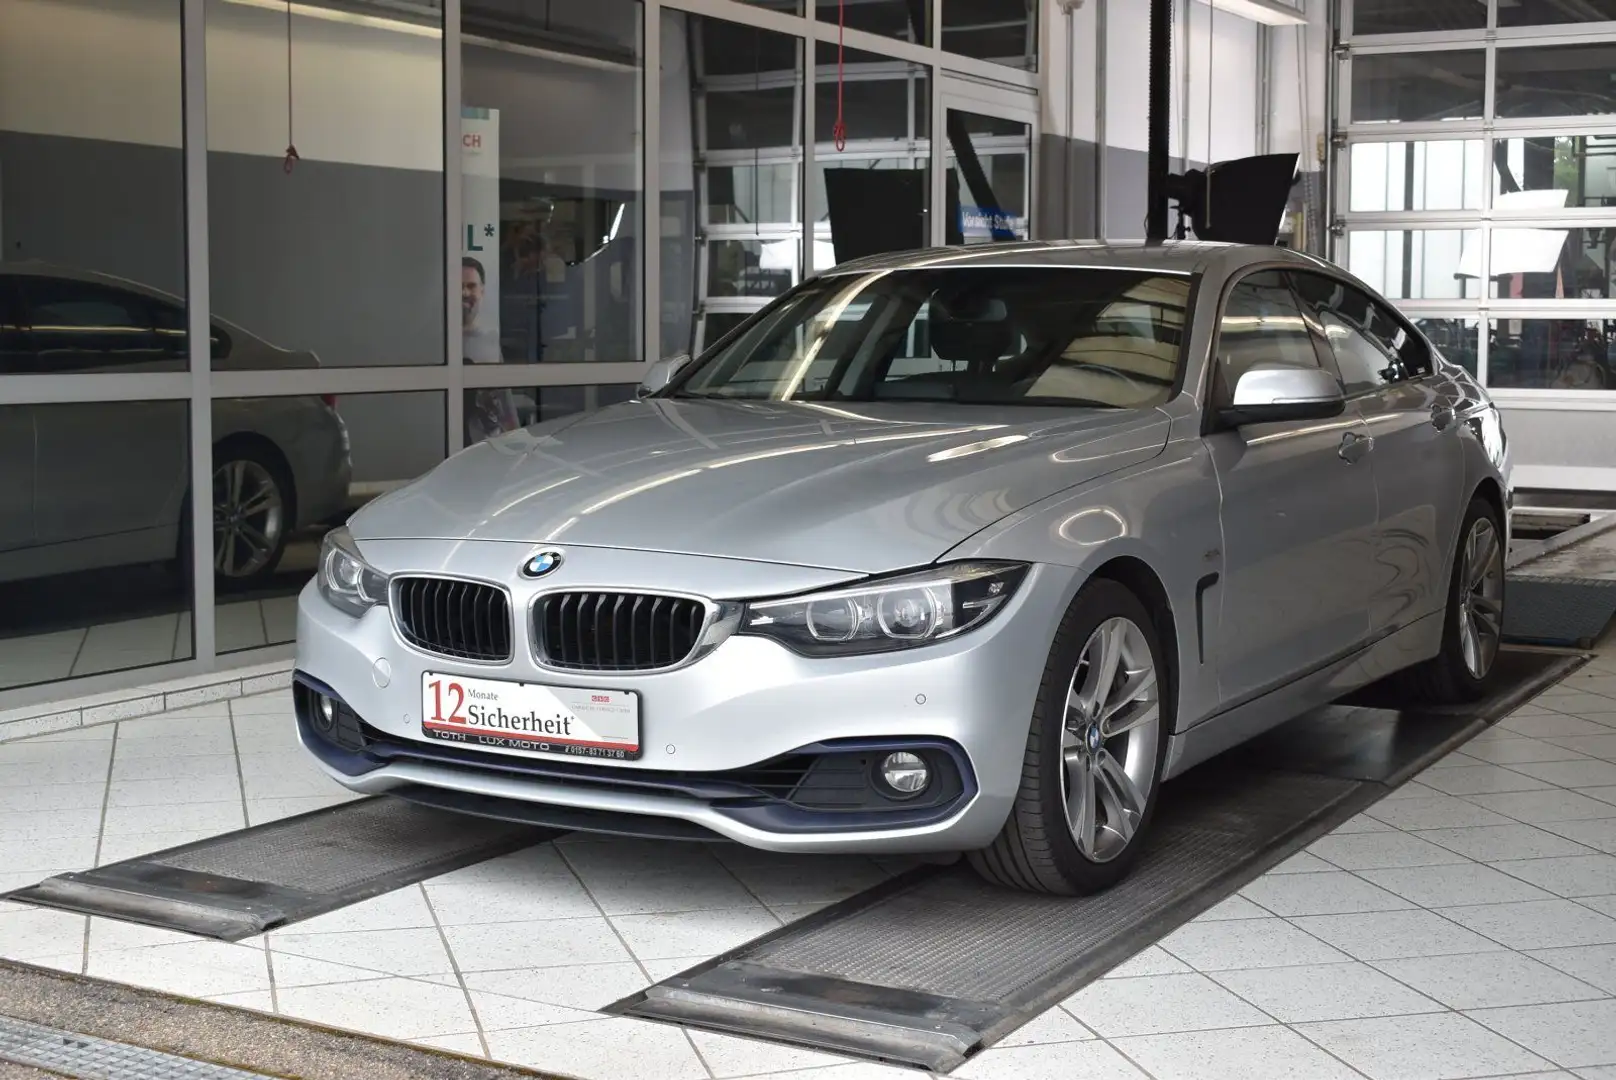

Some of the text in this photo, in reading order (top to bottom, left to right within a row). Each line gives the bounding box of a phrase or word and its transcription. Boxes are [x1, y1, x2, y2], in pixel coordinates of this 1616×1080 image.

[428, 679, 467, 724] 12
[467, 687, 499, 701] Monate
[432, 729, 550, 751] TOTH LUX MOTO
